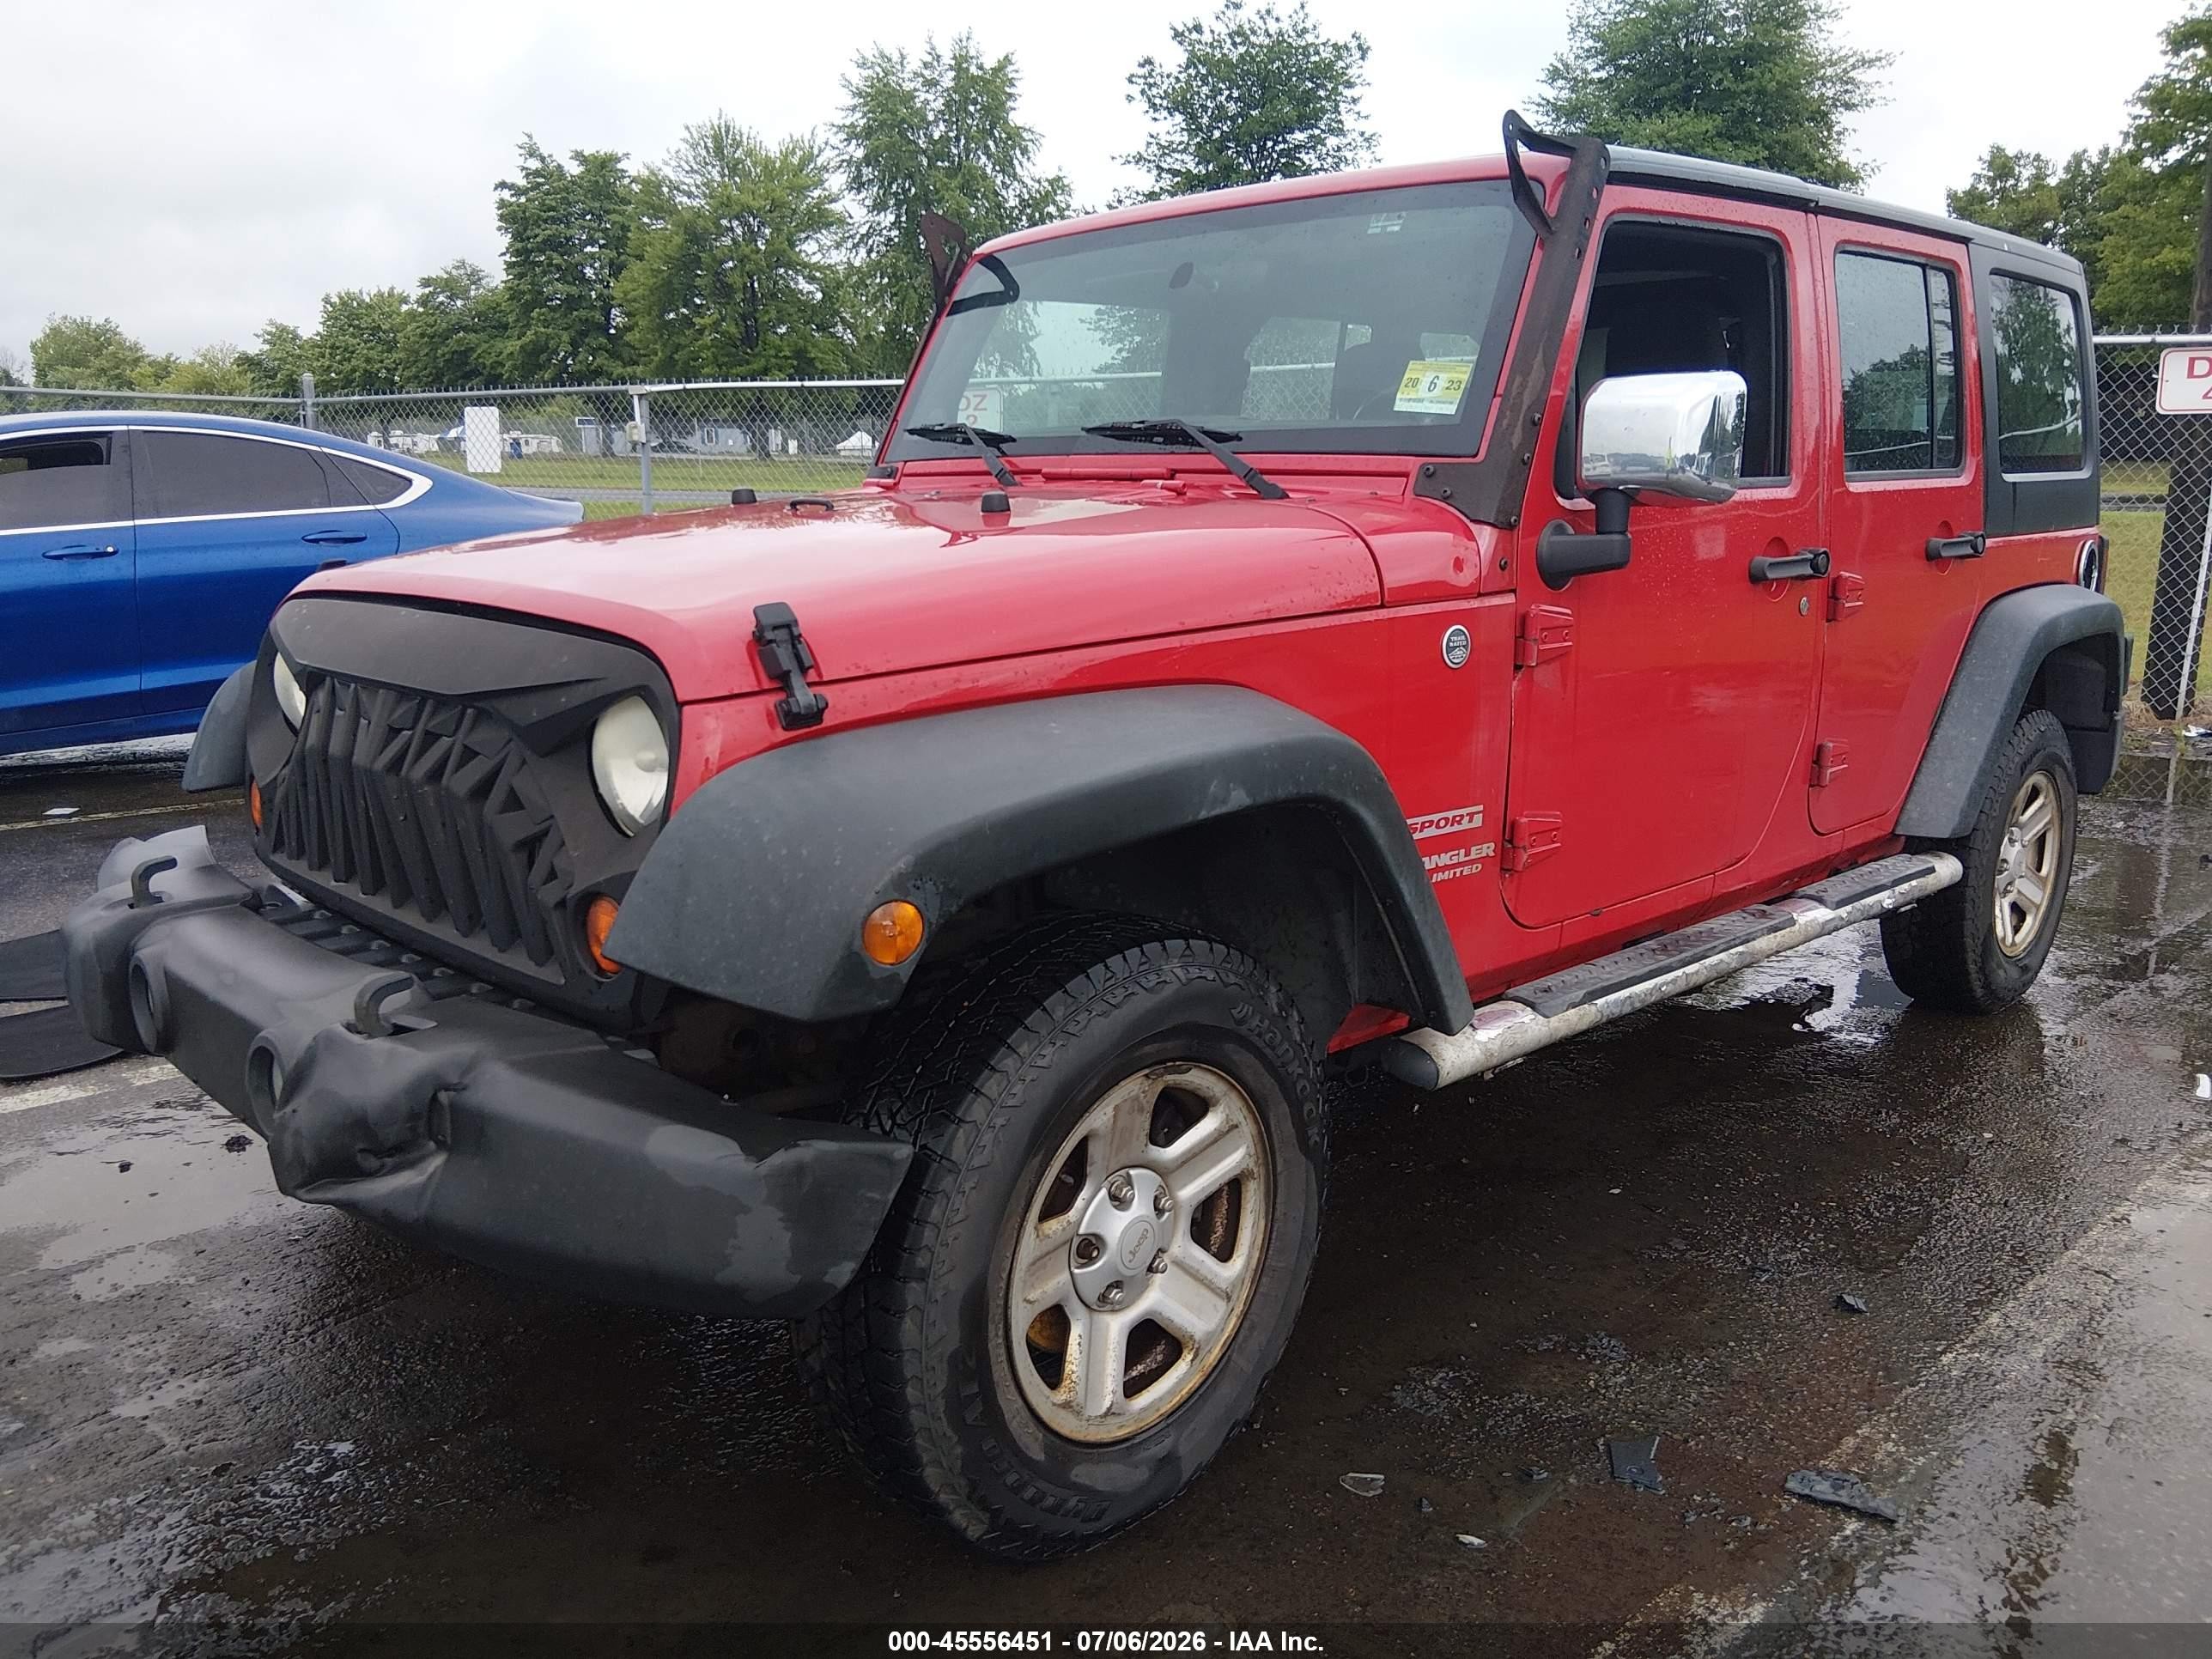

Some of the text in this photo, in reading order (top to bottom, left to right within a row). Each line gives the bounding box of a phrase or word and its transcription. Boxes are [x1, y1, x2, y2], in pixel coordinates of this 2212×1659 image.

[1404, 374, 1462, 393] 20 6 23
[1409, 811, 1482, 835] SPORT
[1128, 1228, 1149, 1263] Jeep
